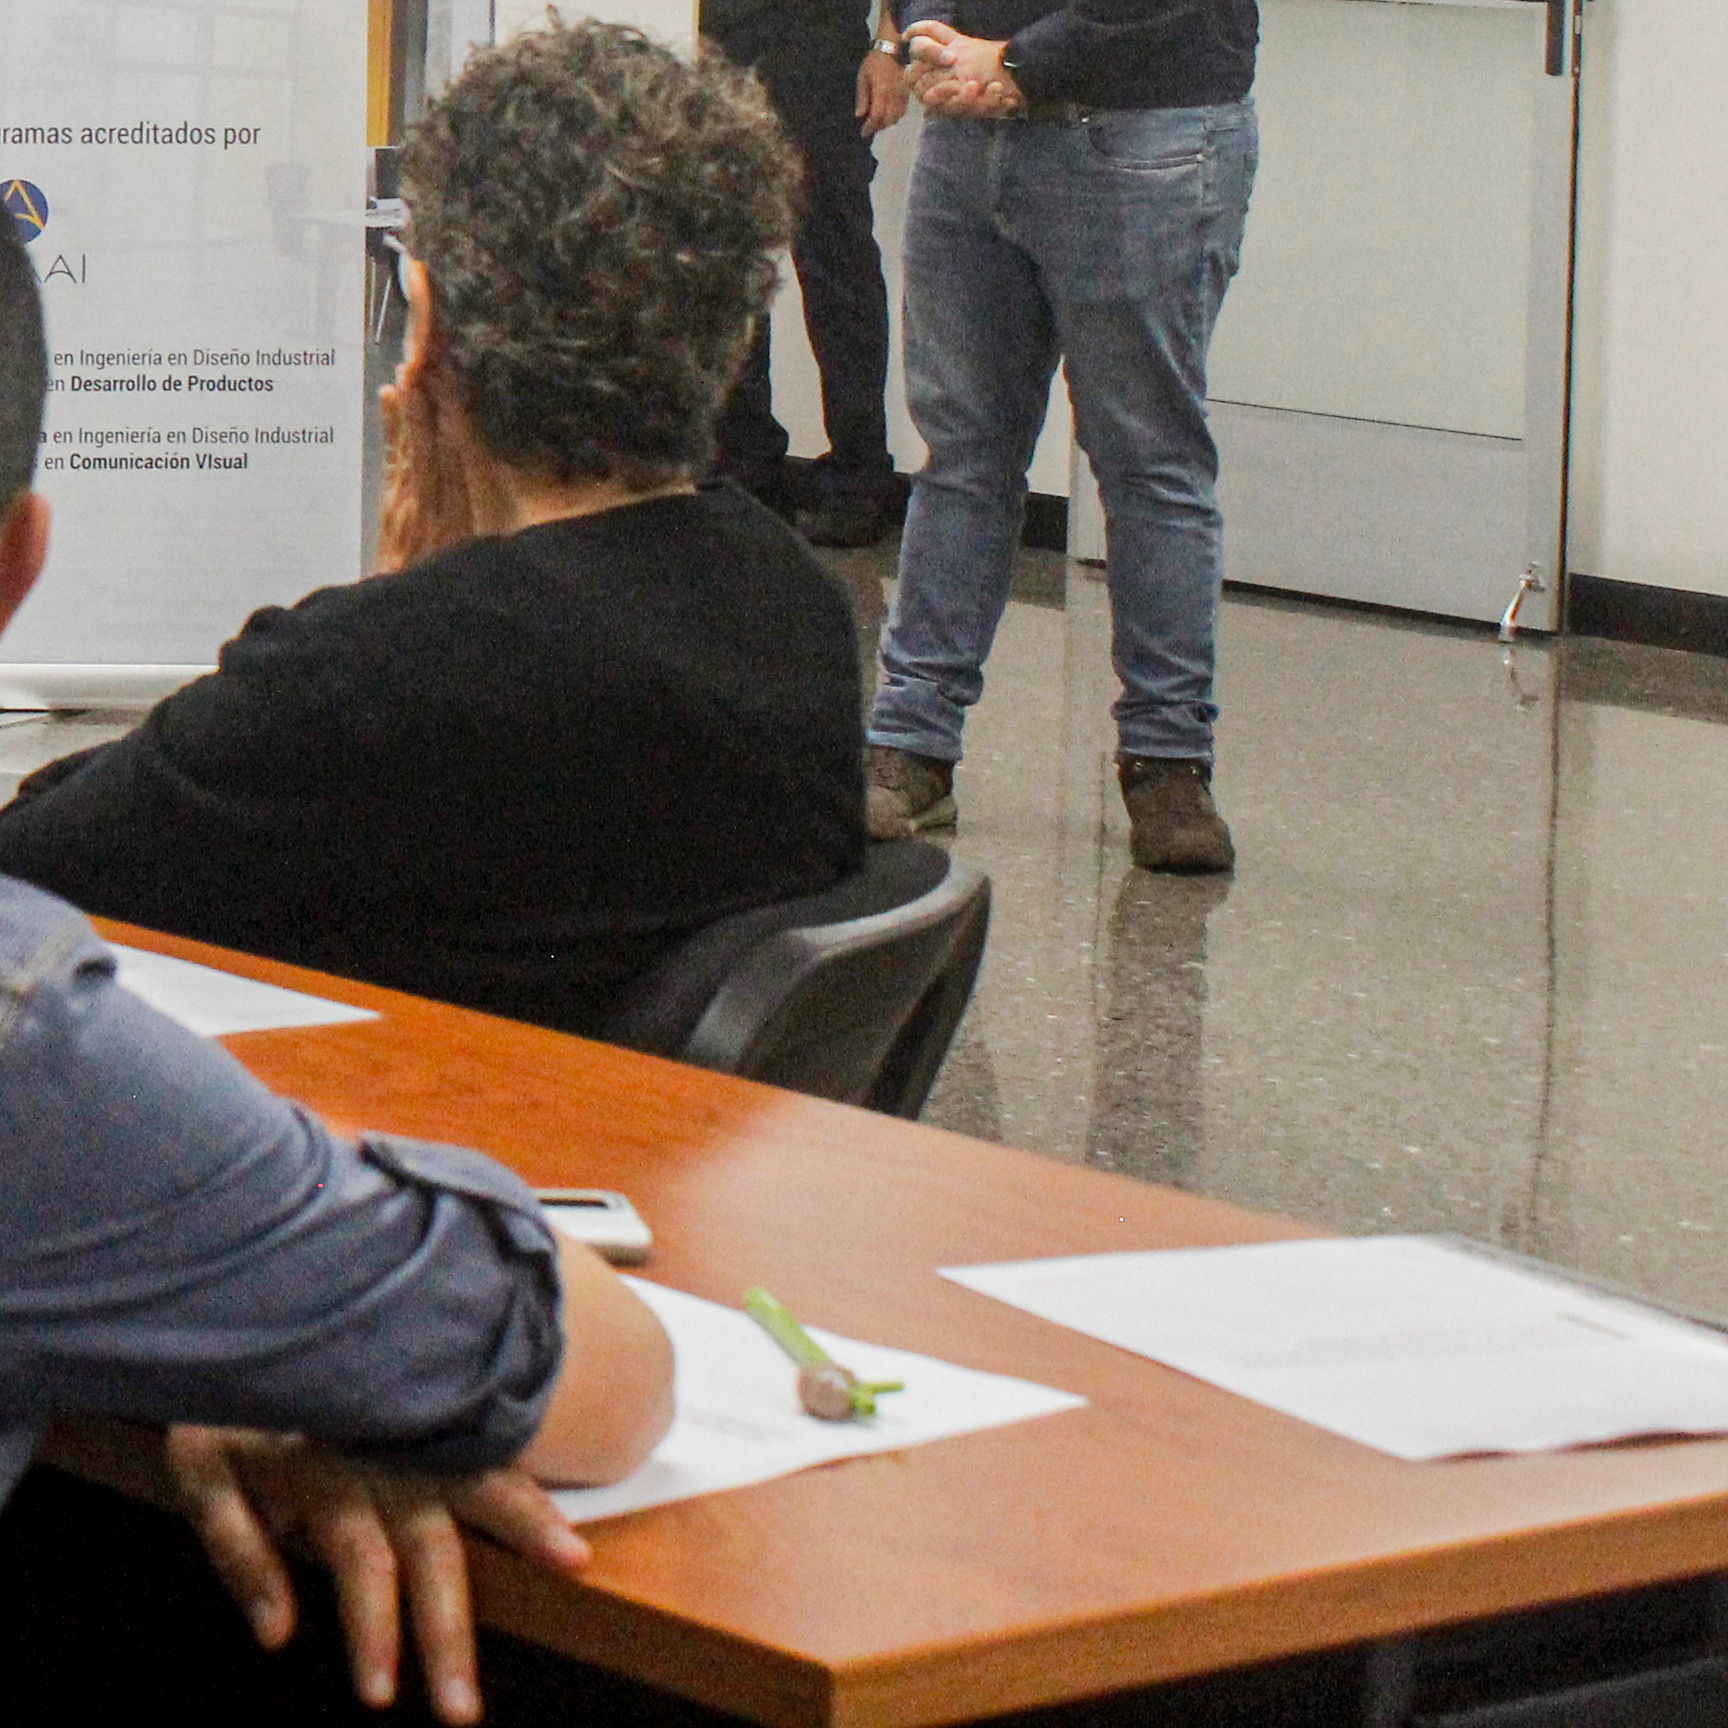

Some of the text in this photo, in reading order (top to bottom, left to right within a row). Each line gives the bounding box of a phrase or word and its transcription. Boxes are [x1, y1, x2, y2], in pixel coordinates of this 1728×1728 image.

[80, 121, 216, 145] acreditados
[223, 126, 262, 151] por
[53, 348, 336, 370] en Ingeniería en Diseño Industrial
[70, 374, 157, 392] Desarrollo
[162, 374, 182, 392] de
[188, 374, 274, 392] Productos
[53, 430, 73, 444] en
[78, 426, 162, 448] Ingeniería
[167, 430, 187, 444] en
[191, 426, 249, 444] Diseño
[254, 426, 334, 444] Industrial
[44, 457, 64, 470] en
[69, 451, 190, 470] Comunicación
